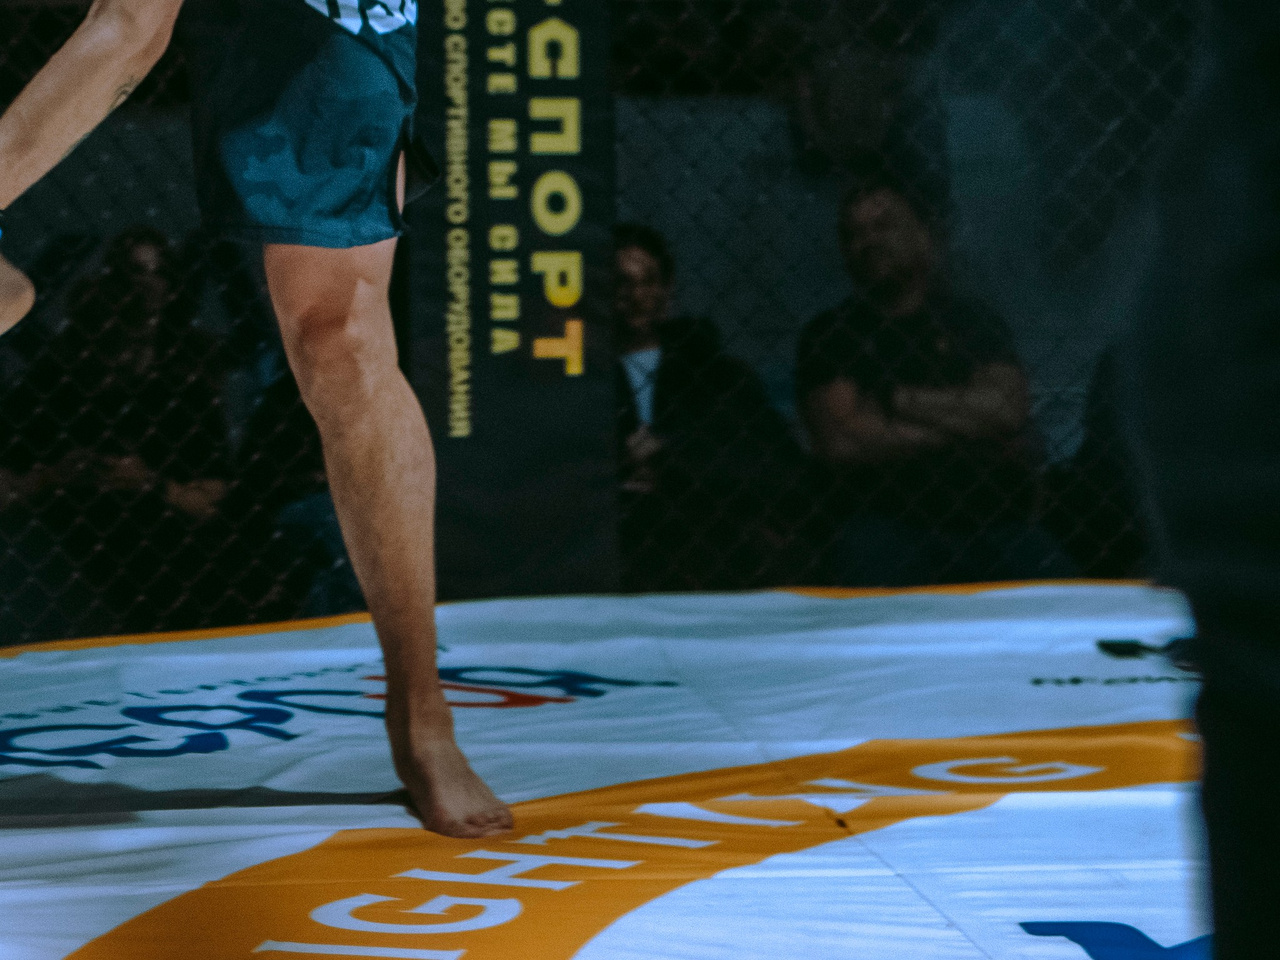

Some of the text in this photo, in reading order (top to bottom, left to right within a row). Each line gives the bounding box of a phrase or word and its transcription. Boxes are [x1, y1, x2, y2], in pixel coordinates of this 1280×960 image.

[445, 33, 470, 225] СПОРТИВНОГО
[487, 119, 518, 198] МЫ
[447, 229, 472, 438] ОБОРУДОВАНИЯ
[489, 225, 520, 354] СИЛА
